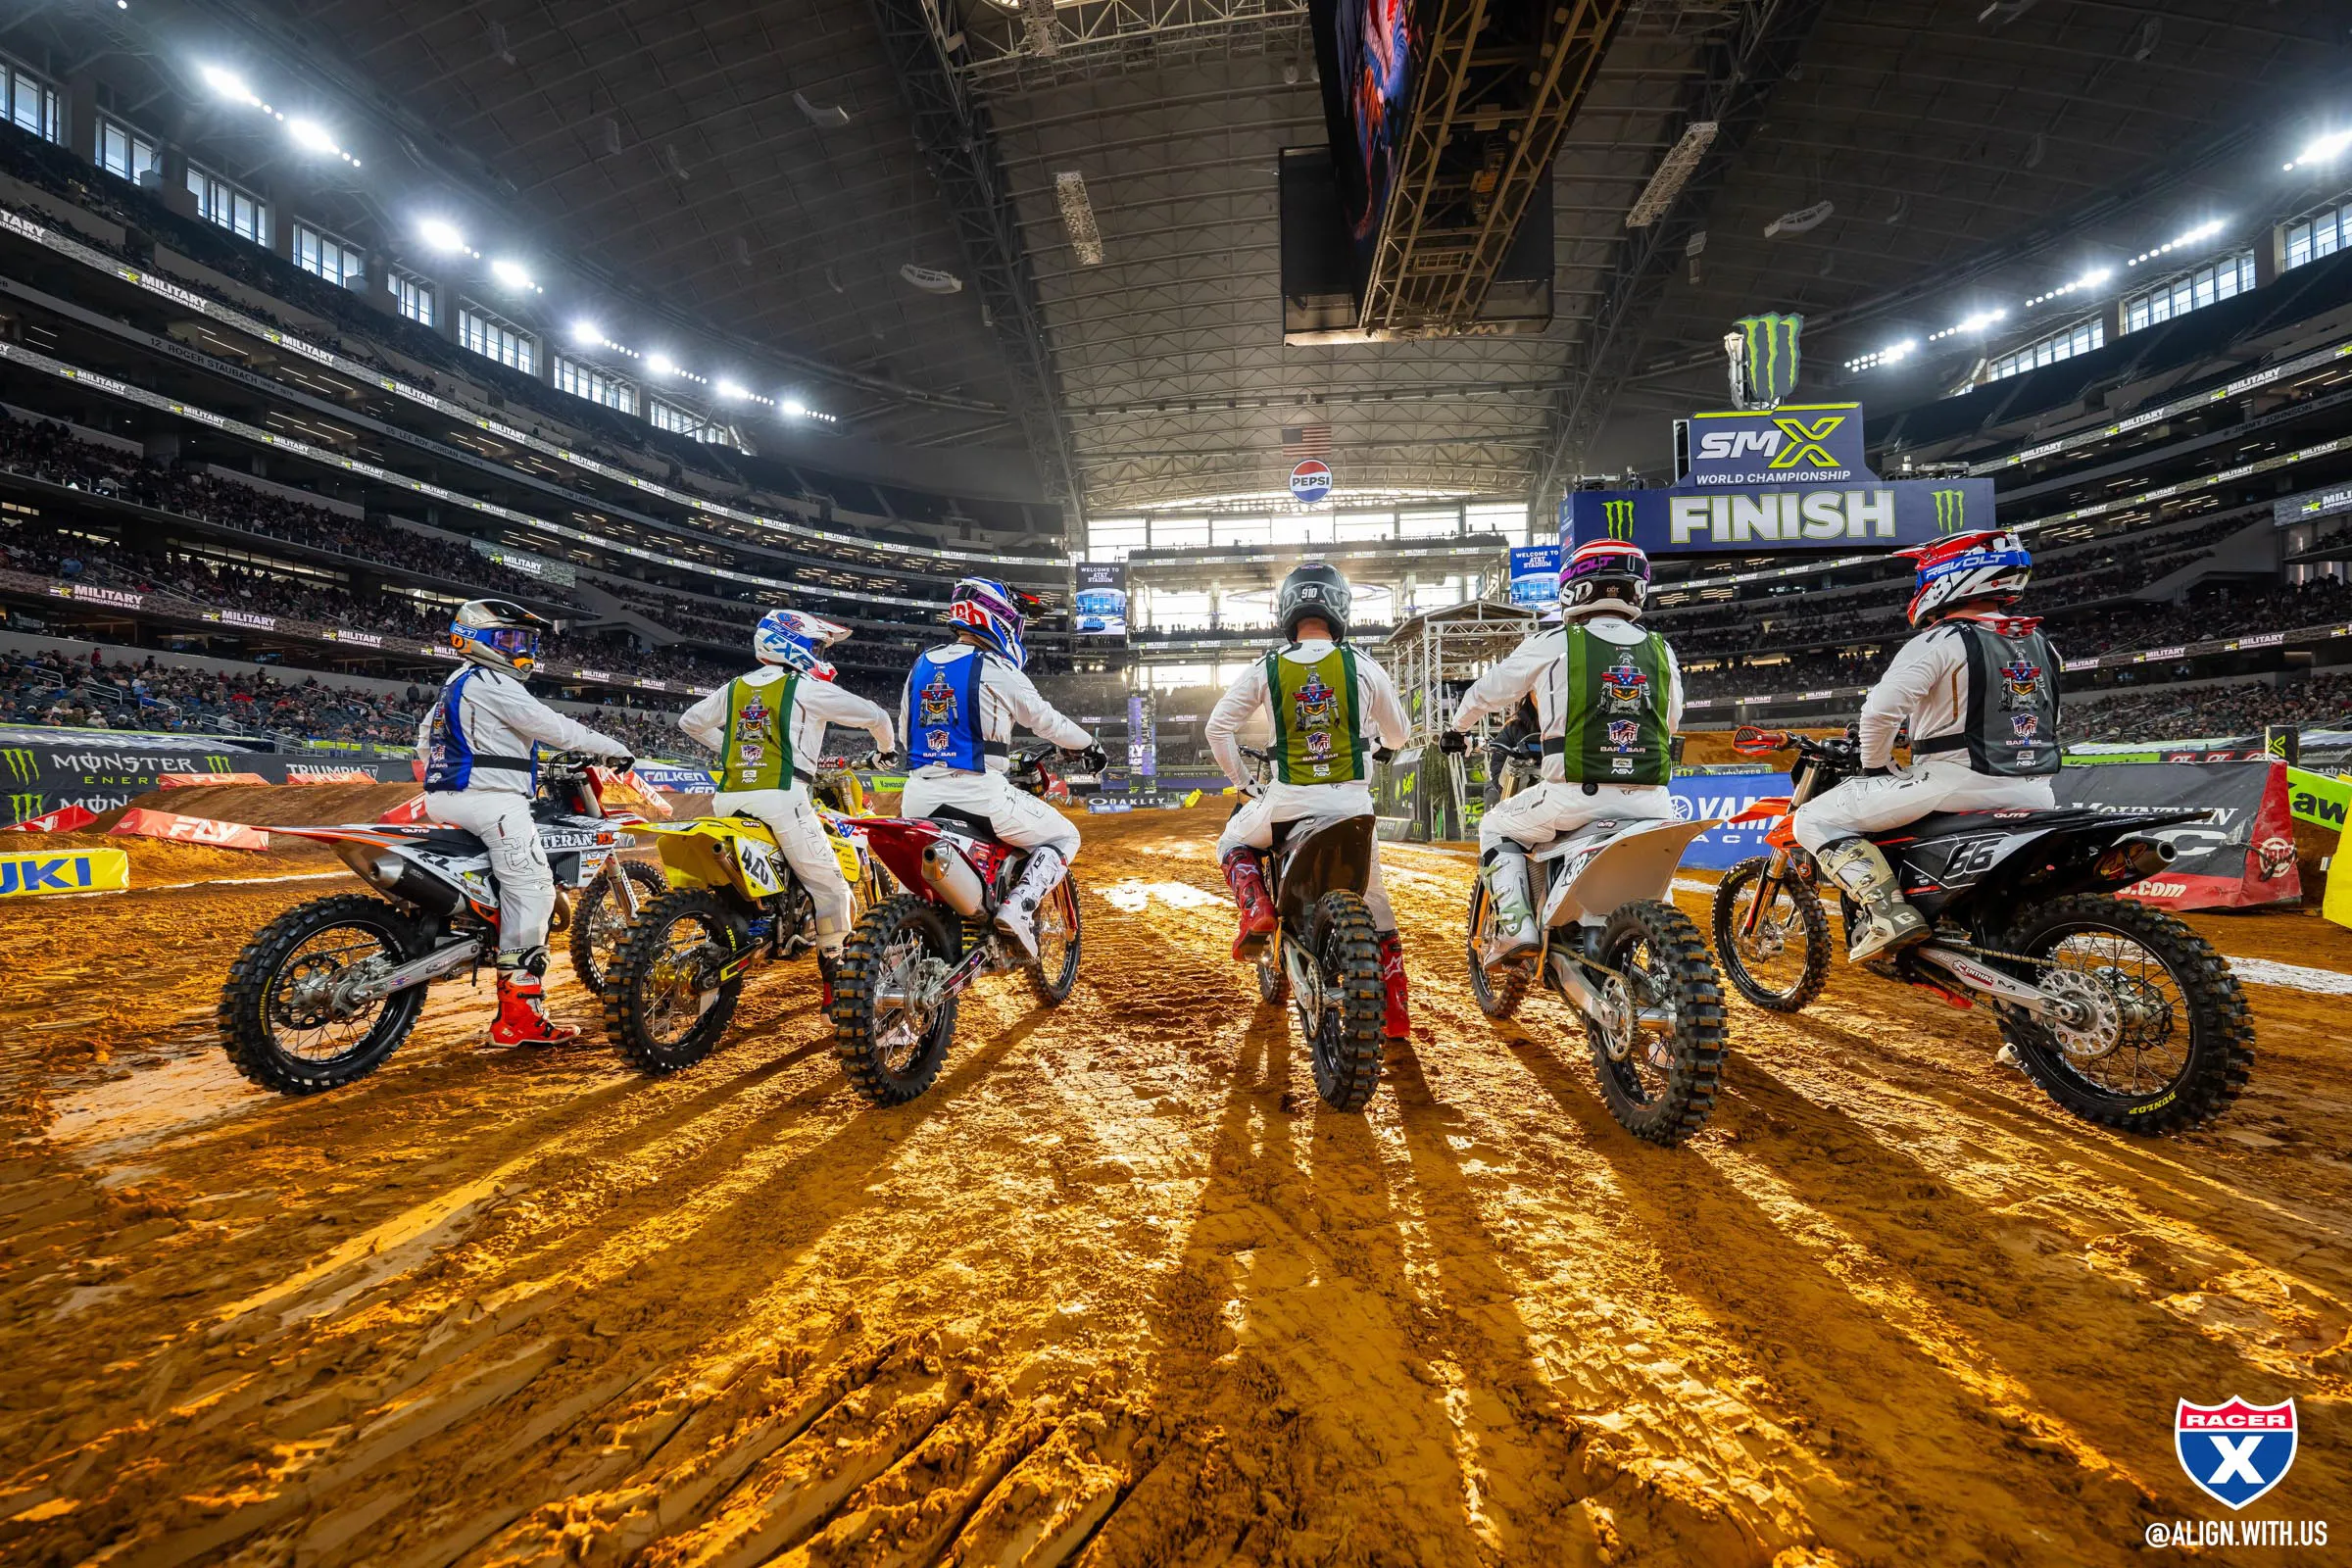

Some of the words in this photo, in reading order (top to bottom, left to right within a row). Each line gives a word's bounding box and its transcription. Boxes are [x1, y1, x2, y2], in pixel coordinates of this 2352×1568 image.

[141, 272, 208, 308] MILITARY
[141, 282, 189, 306] APPRECIATION
[188, 301, 205, 314] RACE
[281, 334, 334, 363] MILITARY
[282, 343, 320, 362] APPRECIATION
[169, 344, 204, 366] ROGER
[208, 359, 258, 385] STAUBACH
[76, 369, 126, 392] MILITARY
[2228, 367, 2281, 392] MILITARY
[395, 381, 439, 406] MILITARY
[184, 406, 224, 424] MILITARY
[2119, 408, 2165, 428] MILITARY
[2234, 418, 2263, 433] JIMMY
[2265, 403, 2313, 423] JOHNSON
[489, 420, 526, 441] MILITARY
[273, 435, 309, 452] MILITARY
[399, 430, 414, 442] LEE
[431, 441, 459, 458] JORDAN
[1696, 416, 1845, 468] SMX
[2299, 441, 2338, 457] MILITARY
[2020, 441, 2063, 459] MILITARY
[569, 452, 601, 469] MILITARY
[352, 462, 384, 476] MILITARY
[2218, 466, 2253, 479] MILITARY
[1293, 476, 1330, 487] PEPSI
[1696, 472, 1743, 485] WORLD
[1746, 470, 1850, 484] CHAMPIONSHIP
[420, 483, 449, 497] MILITARY
[638, 479, 665, 494] MILITARY
[2145, 486, 2177, 498] MILITARY
[481, 503, 507, 514] MILITARY
[702, 502, 729, 514] MILITARY
[2077, 504, 2108, 516] MILITARY
[763, 518, 791, 529] MILITARY
[1669, 490, 1895, 543] FINISH
[536, 520, 559, 530] MILITARY
[2013, 520, 2040, 531] MILITARY
[585, 535, 607, 545] MILITARY
[824, 532, 851, 541] MILITARY
[883, 543, 909, 552] MILITARY
[504, 555, 541, 570] MILITARY
[1926, 554, 2007, 579] REVOLT
[74, 585, 143, 605] MILITARY
[1301, 587, 1318, 599] 910
[74, 595, 123, 608] APPRECIATION
[221, 611, 276, 626] MILITARY
[221, 618, 261, 629] APPRECIATION
[337, 630, 382, 644] MILITARY
[2238, 634, 2284, 647] MILITARY
[433, 646, 458, 657] MILIT
[2145, 648, 2185, 659] MILITARY
[2065, 659, 2100, 668] MILITARY
[582, 669, 610, 679] MILITARY
[52, 751, 198, 774] MONSTER
[286, 763, 362, 775] TRIUMPH
[643, 770, 707, 782] FALKEN
[169, 815, 242, 843] FLY
[2129, 1091, 2177, 1115] DUNLOP
